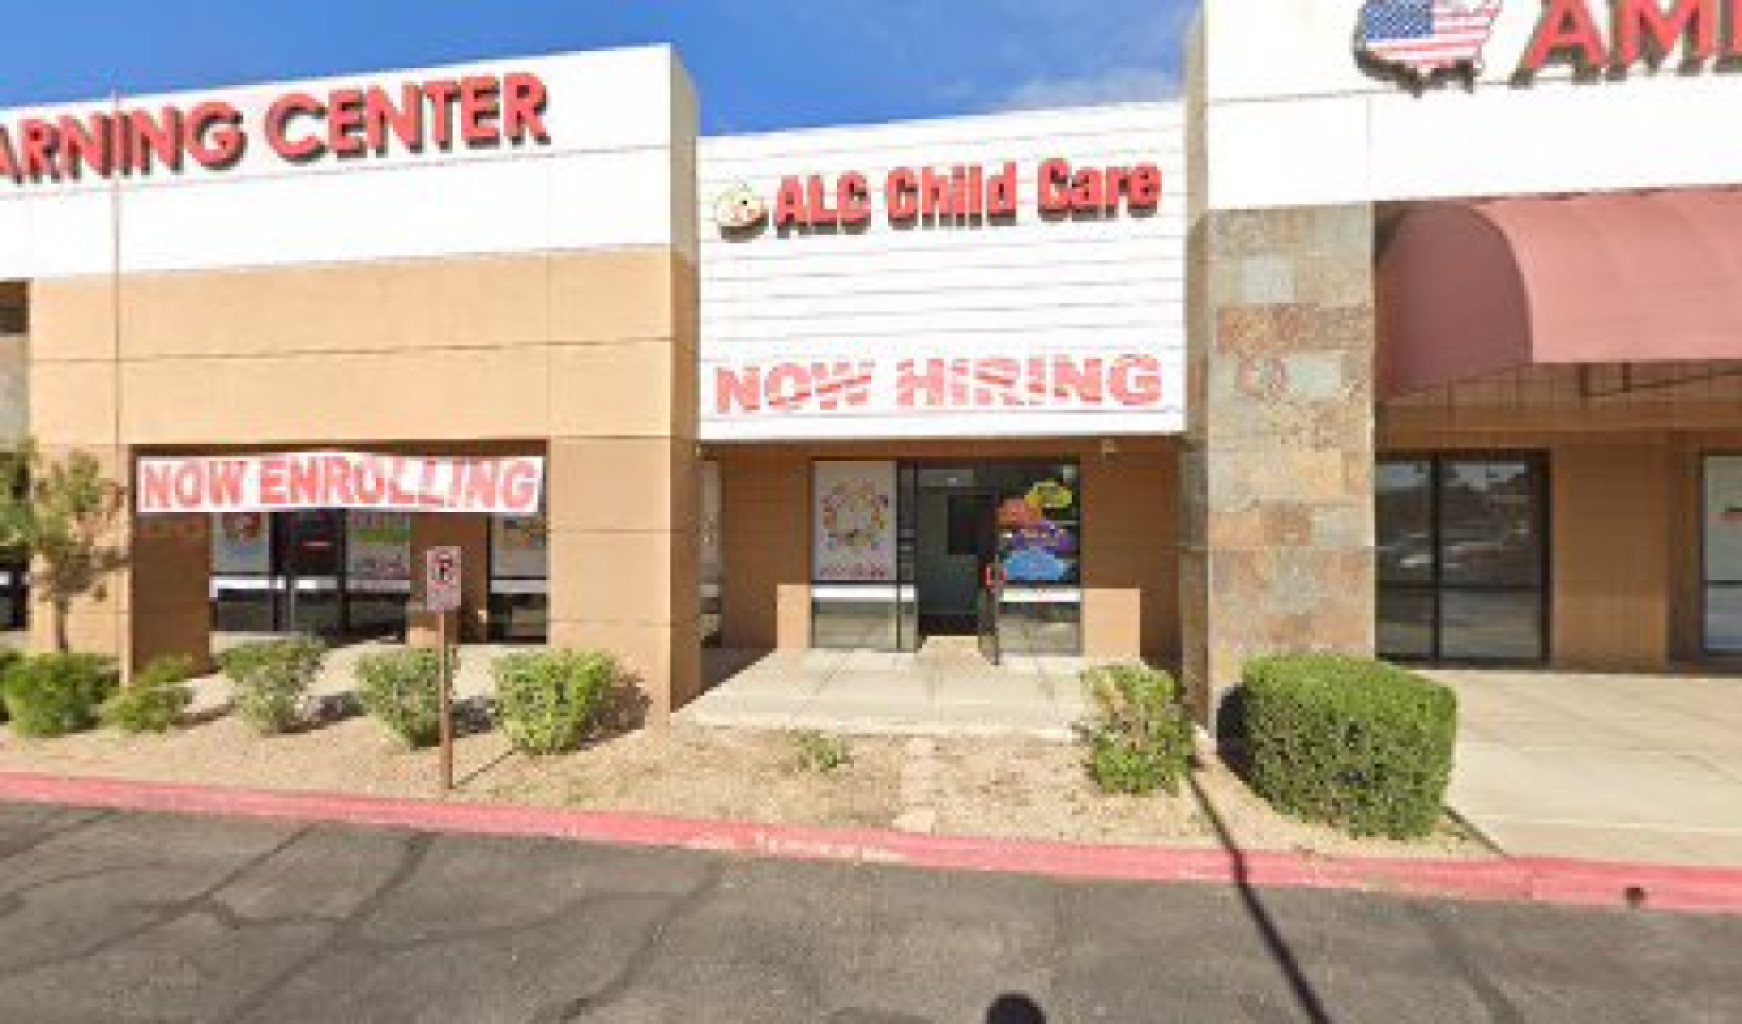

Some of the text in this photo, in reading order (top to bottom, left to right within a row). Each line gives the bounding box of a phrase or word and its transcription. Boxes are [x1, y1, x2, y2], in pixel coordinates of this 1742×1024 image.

[1510, 0, 1742, 88] AM
[264, 72, 551, 163] CENTER
[774, 157, 1163, 239] ALC Child Care
[715, 354, 1163, 414] NOW HIRING
[143, 455, 539, 508] NOW ENROLLING
